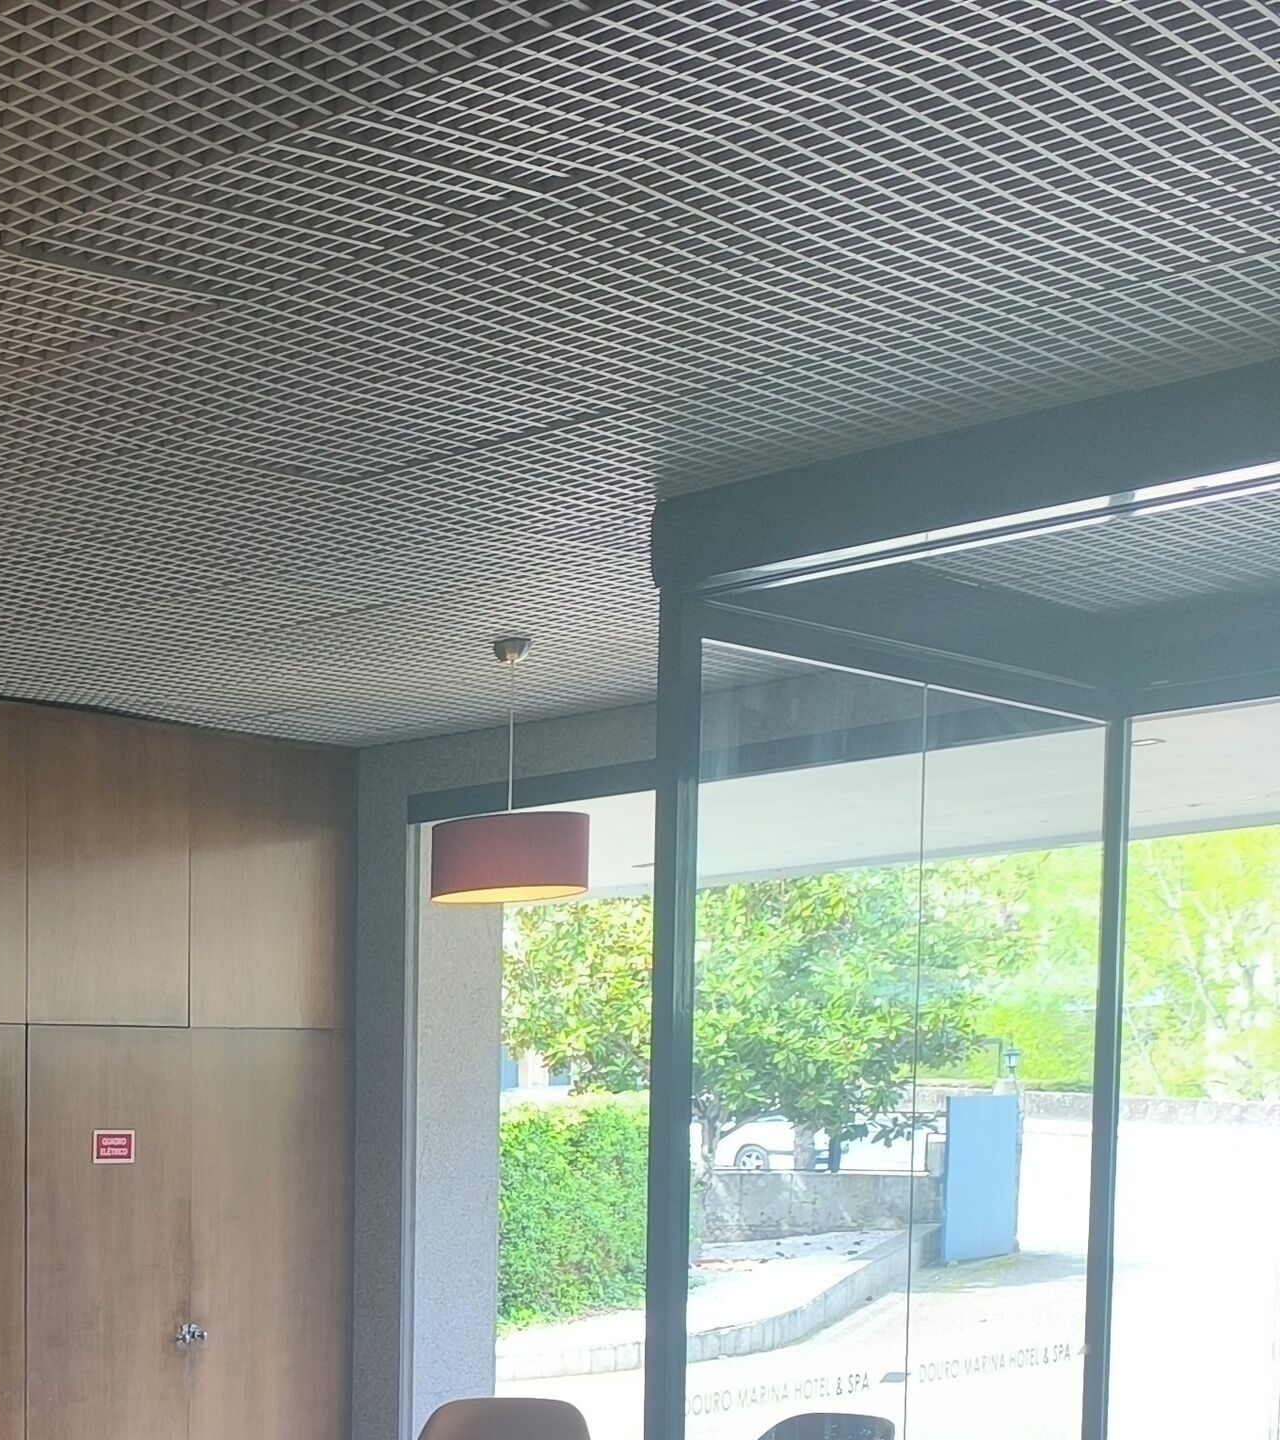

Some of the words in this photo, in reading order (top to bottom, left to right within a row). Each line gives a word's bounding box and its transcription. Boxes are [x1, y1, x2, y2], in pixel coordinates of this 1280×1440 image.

[919, 1359, 960, 1384] DOURO
[964, 1353, 1006, 1375] MARINA
[1009, 1347, 1040, 1369] HOTEL
[1043, 1347, 1049, 1365] &
[1053, 1343, 1071, 1363] SPA
[738, 1383, 789, 1408] MARINA
[794, 1377, 830, 1400] HOTEL
[836, 1377, 843, 1396] &
[848, 1372, 870, 1394] SPA
